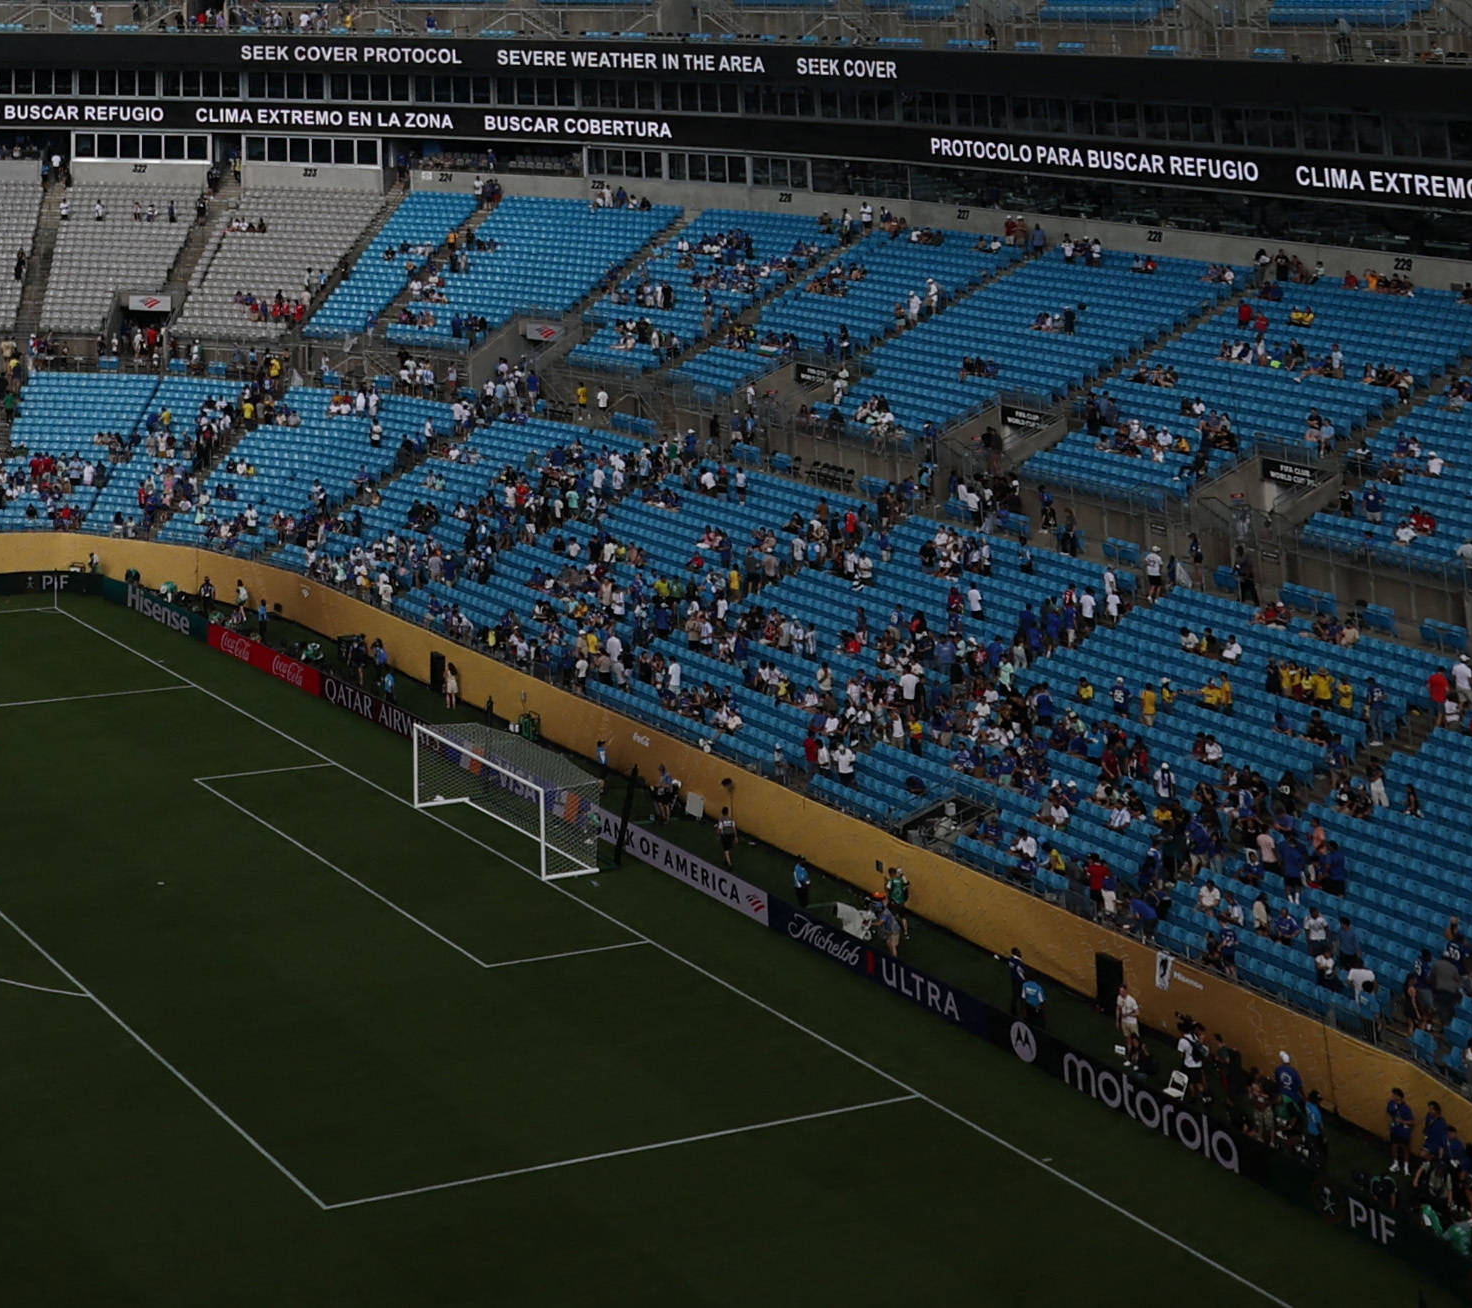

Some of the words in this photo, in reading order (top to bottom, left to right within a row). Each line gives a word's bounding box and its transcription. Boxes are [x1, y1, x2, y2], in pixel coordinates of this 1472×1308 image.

[240, 44, 289, 61] SEEK
[293, 45, 358, 62] COVER
[363, 47, 463, 64] PROTOCOL
[497, 49, 567, 67] SEVERE
[570, 51, 658, 70] WEATHER
[662, 53, 680, 70] IN
[682, 54, 716, 71] THE
[718, 55, 766, 73] AREA
[4, 104, 79, 121] BUSCAR
[84, 105, 164, 122] REFUGIO
[195, 107, 254, 124] CLIMA
[257, 108, 343, 126] EXTREMO
[348, 111, 372, 127] EN
[377, 112, 401, 128] LA
[404, 112, 454, 129] ZONA
[930, 137, 1032, 163] PROTOCOLO
[1036, 145, 1084, 167] PARA
[1087, 149, 1165, 174] BUSCAR
[1169, 155, 1259, 182] REFUGIO
[1295, 165, 1365, 191] CLIMA
[126, 584, 191, 635] Hisense
[220, 631, 251, 663] Coca-Cola
[271, 654, 305, 687] Coca-Cola
[639, 836, 659, 860] OF
[664, 849, 742, 905] AMERICA
[786, 910, 862, 970] Michelob
[881, 955, 962, 1023] ULTRA
[1061, 1050, 1241, 1175] motorola
[1348, 1195, 1397, 1247] PIF
